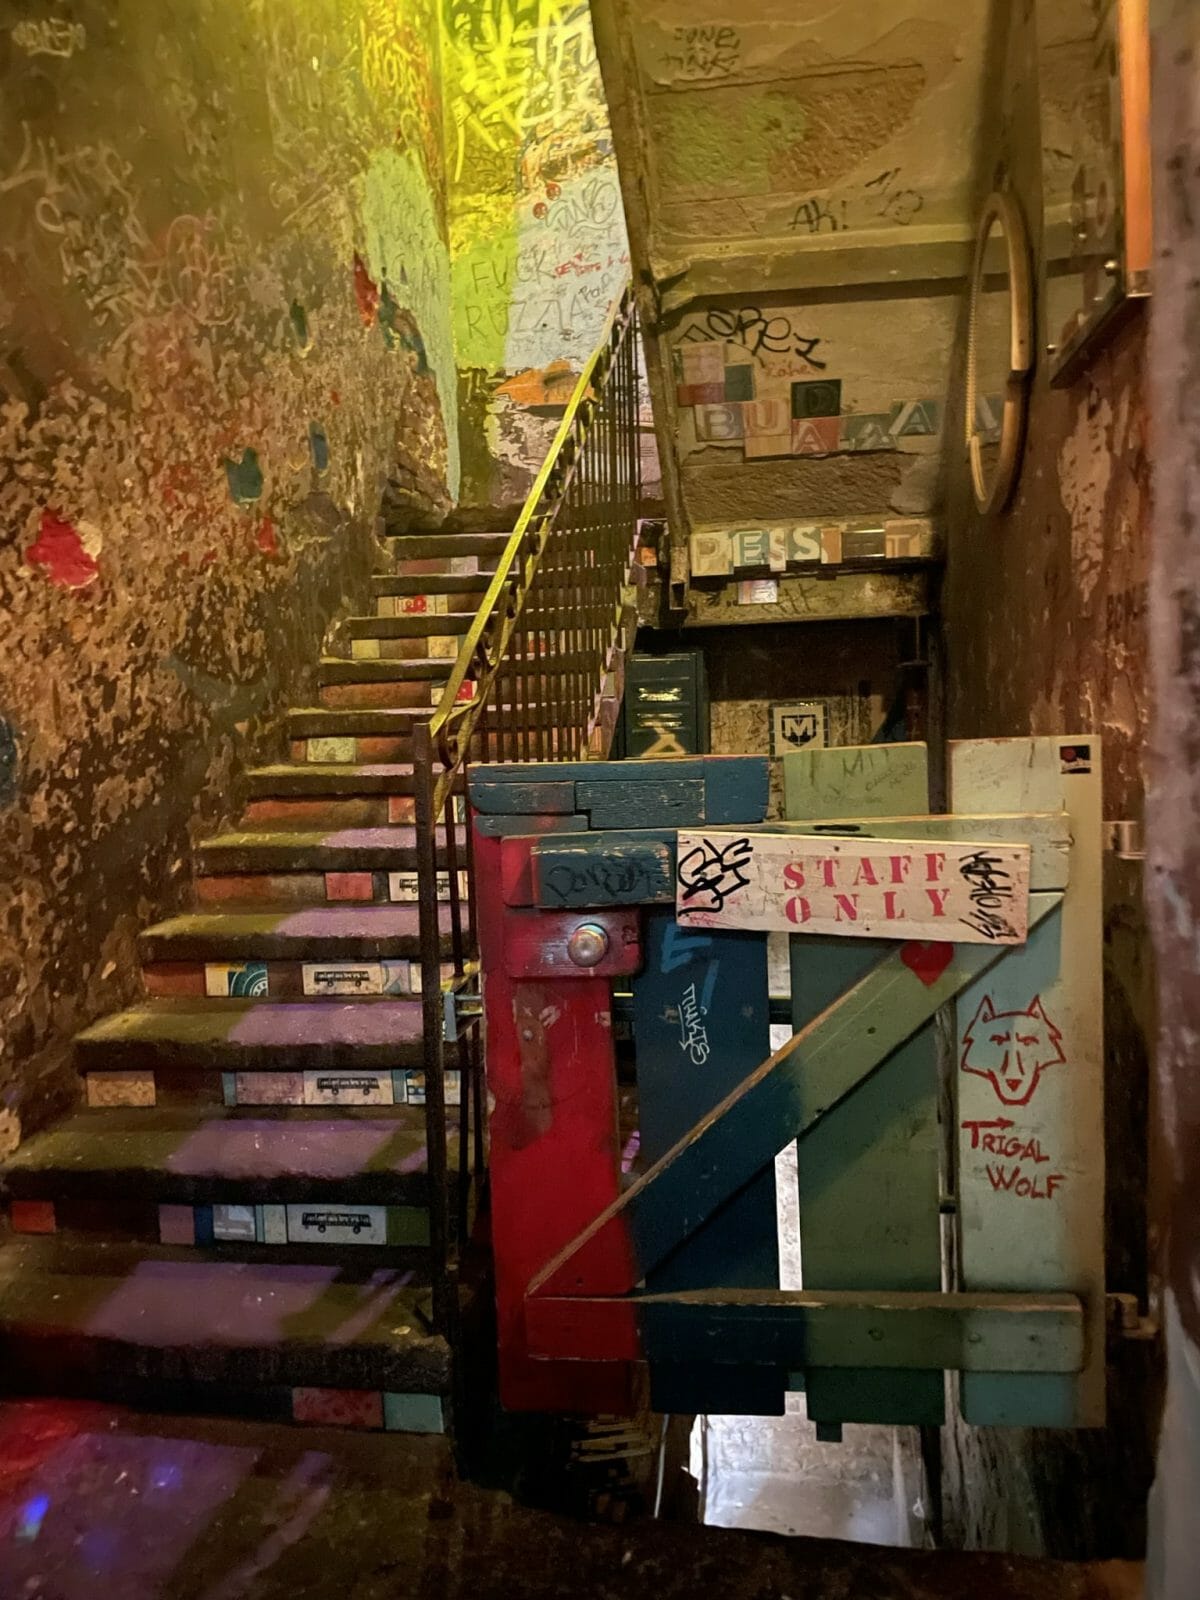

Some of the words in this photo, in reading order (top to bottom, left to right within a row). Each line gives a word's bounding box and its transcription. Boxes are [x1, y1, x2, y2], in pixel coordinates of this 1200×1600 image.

[471, 250, 557, 294] FUCK
[783, 852, 947, 890] STAFF
[785, 888, 950, 924] ONLY
[986, 1163, 1067, 1200] WOLF
